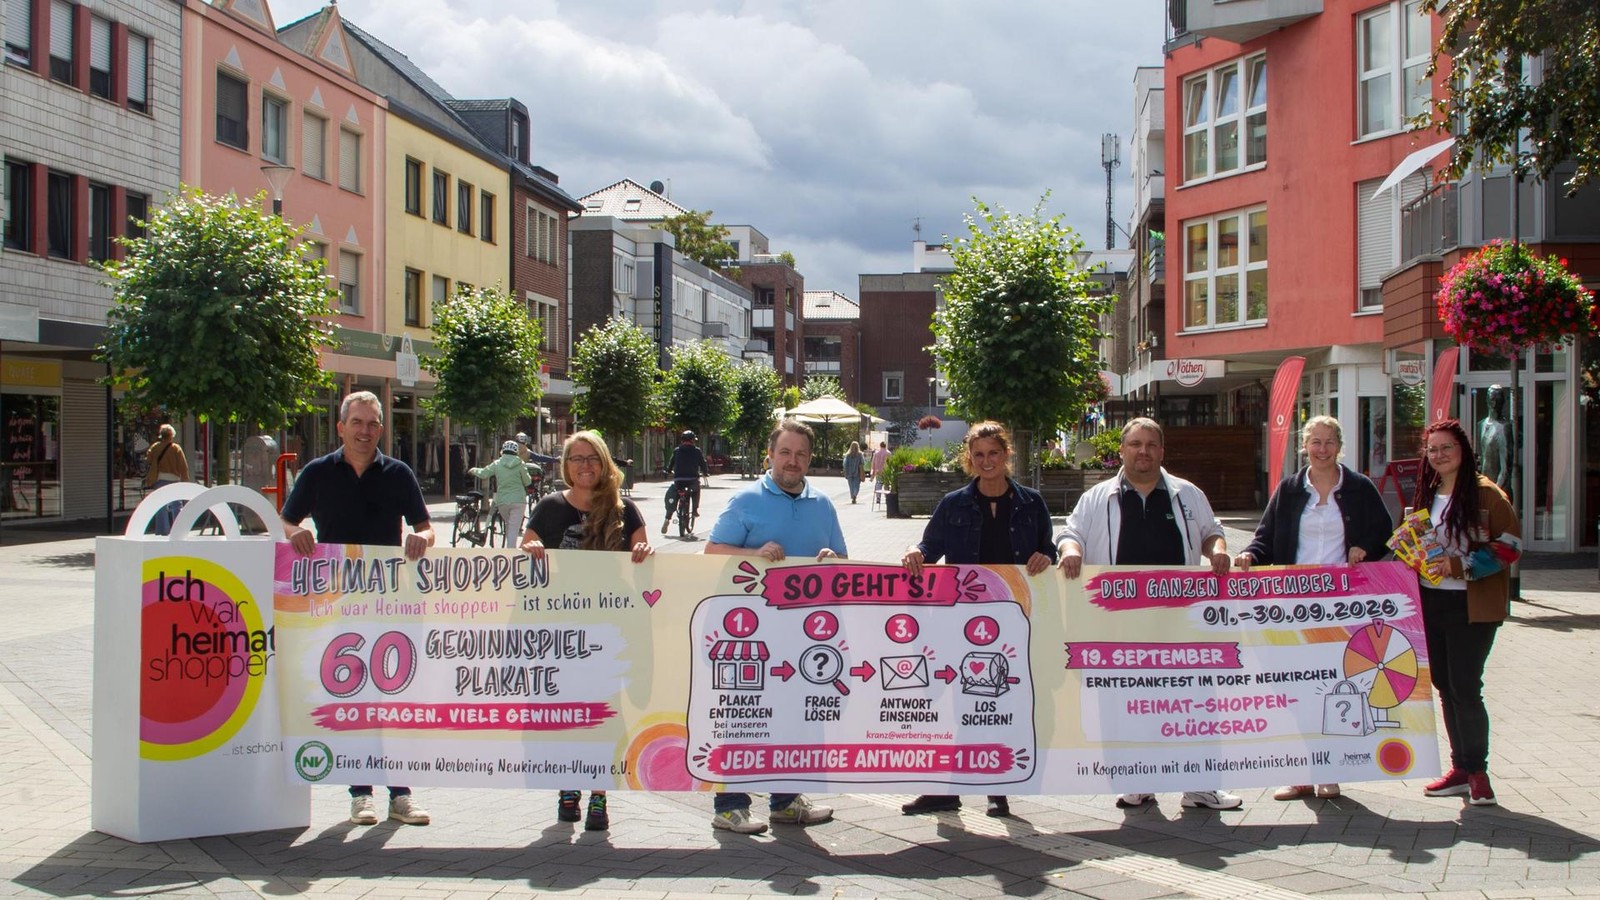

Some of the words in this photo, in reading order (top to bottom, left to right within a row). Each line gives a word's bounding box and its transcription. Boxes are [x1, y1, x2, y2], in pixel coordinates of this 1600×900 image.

[291, 557, 407, 597] HEIMAT
[416, 553, 550, 594] SHOPPEN
[158, 570, 205, 602] Ich
[783, 573, 823, 601] SO
[831, 572, 936, 598] GEHT'S!
[1100, 577, 1137, 599] DEN
[1146, 576, 1220, 599] GANZEN
[1227, 573, 1335, 598] SEPTEMBER
[189, 600, 248, 624] war
[309, 601, 334, 617] Ich
[341, 603, 369, 617] war
[375, 599, 428, 616] Heimat
[434, 598, 500, 620] shoppen
[523, 594, 541, 612] ist
[546, 592, 592, 611] schön
[599, 591, 636, 610] hier.
[733, 612, 750, 633] 1.
[813, 615, 832, 635] 2.
[895, 618, 913, 638] 3.
[974, 621, 993, 641] 4.
[172, 623, 275, 656] heimat
[425, 629, 603, 660] GEWINNSPIEL-
[319, 630, 418, 698] 60
[1081, 648, 1108, 666] 19.
[1112, 648, 1224, 666] SEPTEMBER
[454, 665, 560, 696] PLAKATE
[1086, 675, 1194, 688] ERNTEDANKFEST
[1199, 675, 1214, 687] IM
[1217, 674, 1252, 687] DORF
[1255, 669, 1338, 684] NEUKIRCHEN
[719, 694, 761, 707] PLAKAT
[805, 695, 841, 709] FRAGE
[880, 698, 933, 711] ANTWORT
[975, 701, 997, 713] LOS
[1126, 694, 1299, 715] HEIMAT-SHOPPEN-
[335, 708, 359, 722] 60
[366, 707, 443, 723] FRAGEN.
[449, 708, 500, 723] VIELE
[506, 707, 592, 723] GEWINNE!
[709, 706, 773, 720] ENTDECKEN
[804, 707, 841, 722] LÖSEN
[880, 709, 939, 723] EINSENDEN
[961, 713, 1013, 727] SICHERN!
[712, 729, 771, 740] Teilnehmern
[714, 719, 728, 730] bei
[731, 720, 768, 730] unseren
[1161, 717, 1268, 738] GLÜCKSRAD
[866, 730, 954, 741] kranz@werbering-nv.de
[246, 741, 278, 754] schön
[1343, 752, 1372, 761] heimat
[302, 756, 326, 768] NV
[336, 754, 362, 770] Eine
[366, 755, 403, 771] Aktion
[407, 760, 431, 772] vom
[436, 756, 494, 776] Werbering
[497, 758, 607, 780] Neukirchen-Vluyn
[610, 760, 632, 776] e.V.
[720, 751, 765, 771] JEDE
[772, 749, 849, 770] RICHTIGE
[854, 749, 937, 769] ANTWORT
[954, 750, 963, 768] 1
[968, 749, 1000, 769] LOS
[1076, 762, 1089, 776] in
[1092, 761, 1158, 780] Kooperation
[1161, 760, 1180, 774] mit
[1183, 759, 1201, 773] der
[1204, 754, 1308, 773] Niederrheinischen
[1311, 751, 1332, 766] IHK
